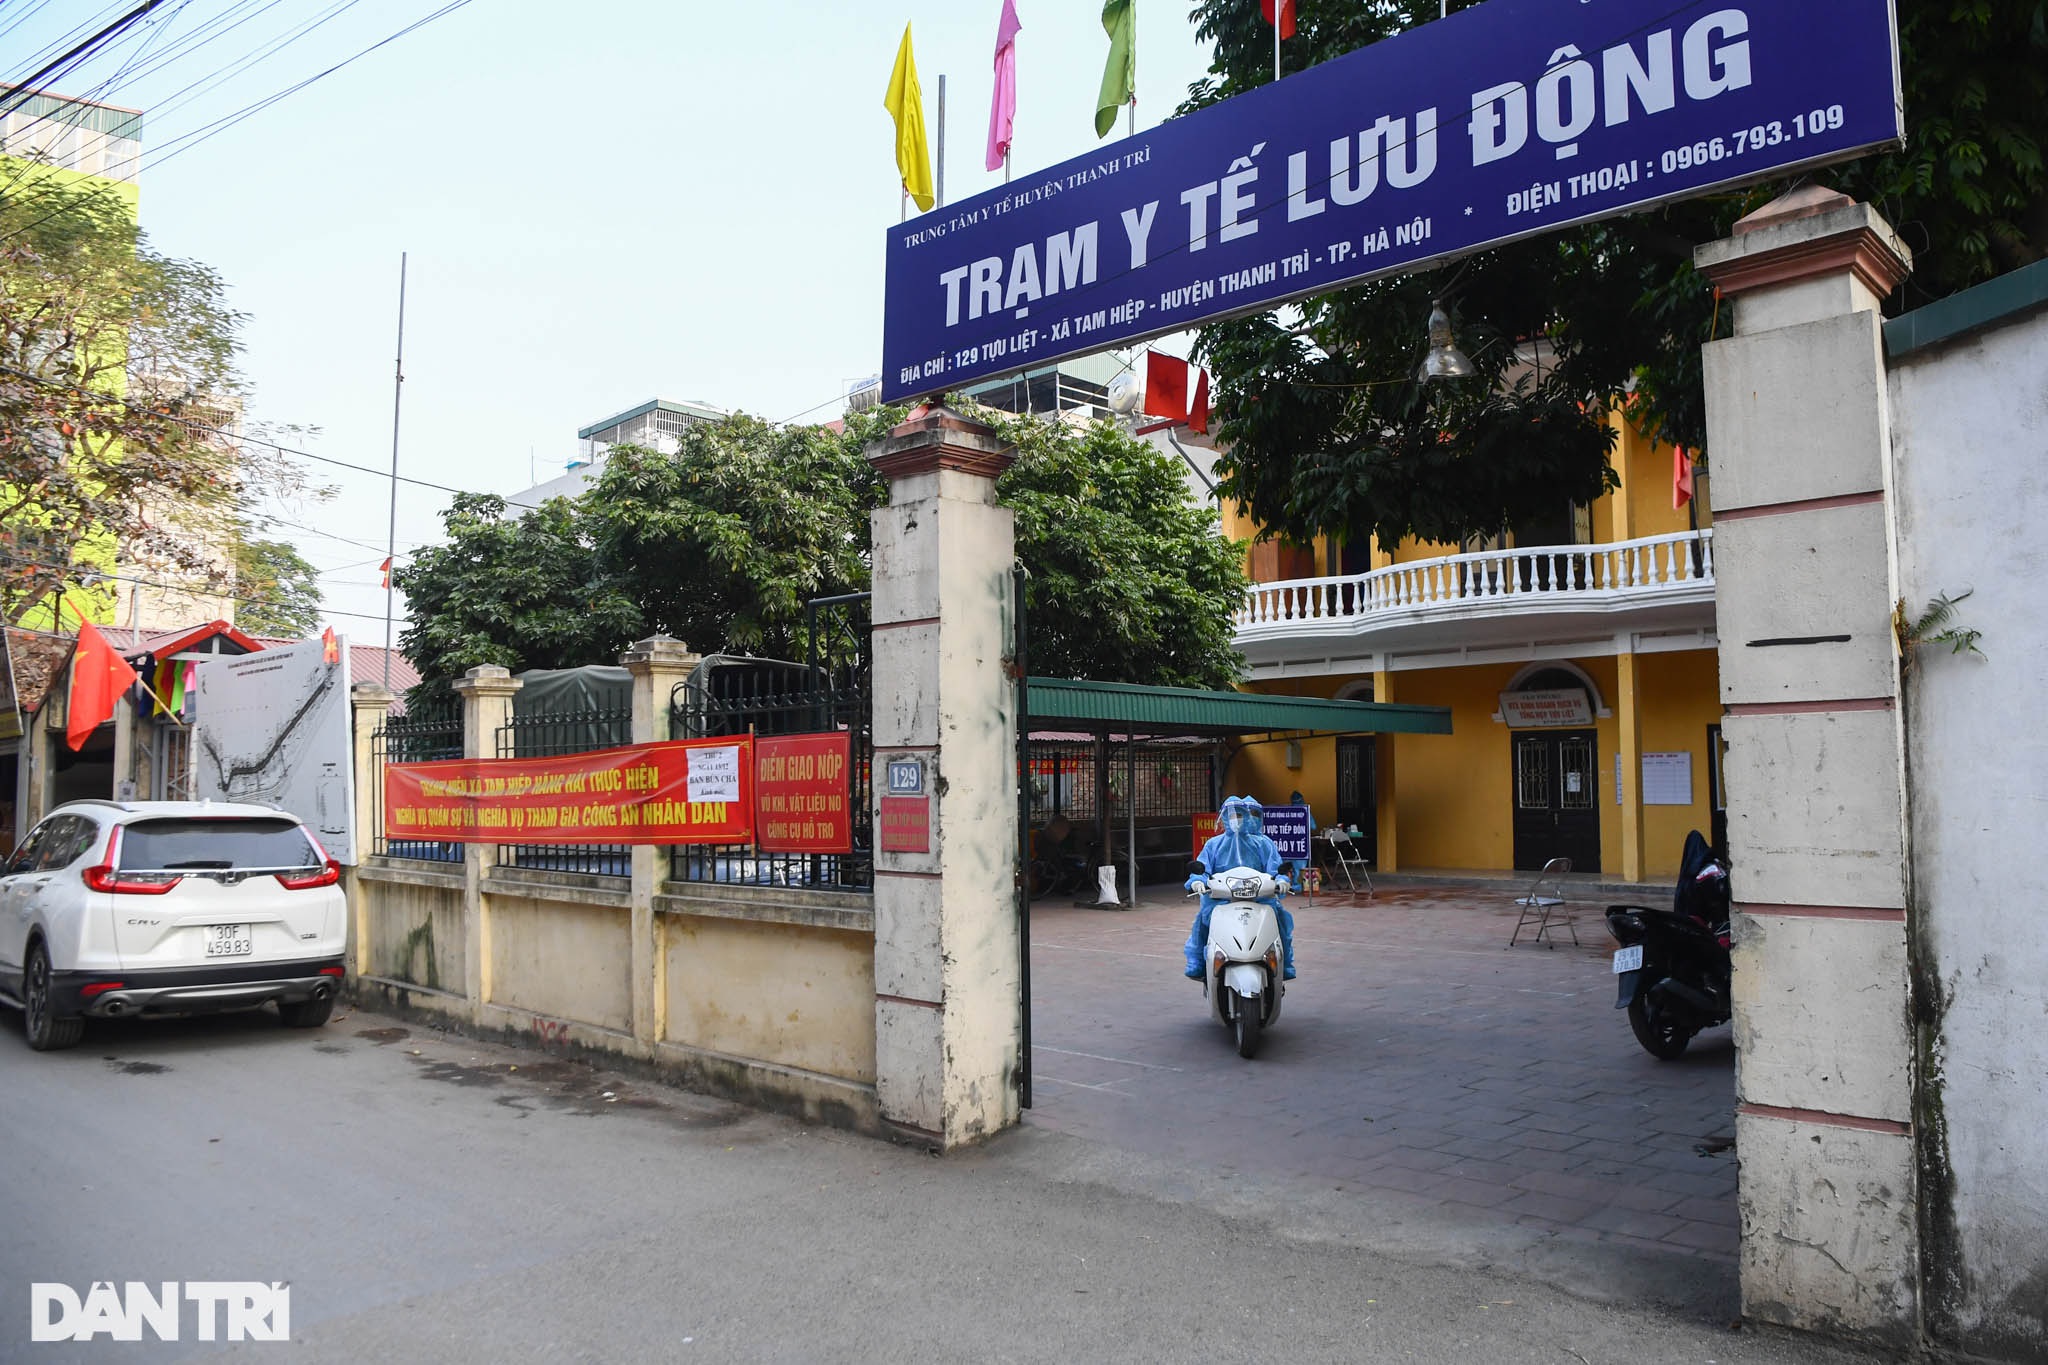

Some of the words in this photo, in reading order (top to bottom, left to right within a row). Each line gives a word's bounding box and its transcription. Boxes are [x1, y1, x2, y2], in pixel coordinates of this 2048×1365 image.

[940, 220, 1098, 327] TRẠM
[1120, 200, 1160, 270] Y
[1181, 141, 1268, 253] TẾ
[1287, 106, 1438, 223] LƯU
[1467, 8, 1752, 168] ĐỘNG
[1506, 182, 1561, 217] ĐIỆN
[1568, 161, 1639, 199] THOẠI
[1660, 104, 1845, 175] 0966.793.109
[904, 223, 946, 249] TRUNG
[949, 209, 980, 233] TÂM
[981, 206, 991, 220] Y
[993, 192, 1014, 217] TẾ
[1014, 181, 1064, 209] HUYỆN
[1067, 160, 1120, 190] THANH
[1123, 144, 1151, 170] TRÌ
[900, 363, 921, 386] ĐỊA
[923, 350, 946, 378] CHỈ
[955, 347, 979, 368] 129
[982, 336, 1007, 362] TỰU
[1010, 328, 1039, 354] LIỆT
[1051, 313, 1071, 342] XÃ
[1074, 310, 1106, 336] TAM
[1110, 298, 1145, 326] HIỆP
[1160, 279, 1214, 312] HUYỆN
[1219, 262, 1276, 295] THANH
[1281, 248, 1310, 278] TRÌ
[1328, 240, 1357, 266] TP.
[1363, 226, 1390, 256] HÀ
[1396, 216, 1432, 247] NỘI
[484, 777, 506, 797] TAM
[590, 767, 623, 797] THỰC
[625, 762, 660, 795] HIỆN
[787, 754, 814, 781] GIAO
[817, 748, 843, 785] NỘP
[892, 766, 918, 788] 129
[477, 803, 508, 828] NGHĨA
[510, 807, 524, 832] VỤ
[526, 806, 558, 828] THAM
[560, 805, 580, 827] GIA
[582, 800, 618, 827] CÔNG
[620, 803, 640, 826] AN
[643, 797, 687, 825] NHÂN
[789, 791, 805, 816] VẬT
[806, 790, 826, 816] LIỆU
[1266, 825, 1279, 836] VỰC
[1279, 822, 1292, 834] TIẾP
[1290, 840, 1295, 852] Y
[1296, 837, 1306, 852] TẾ
[207, 940, 251, 955] 459.83
[216, 926, 239, 939] 30F
